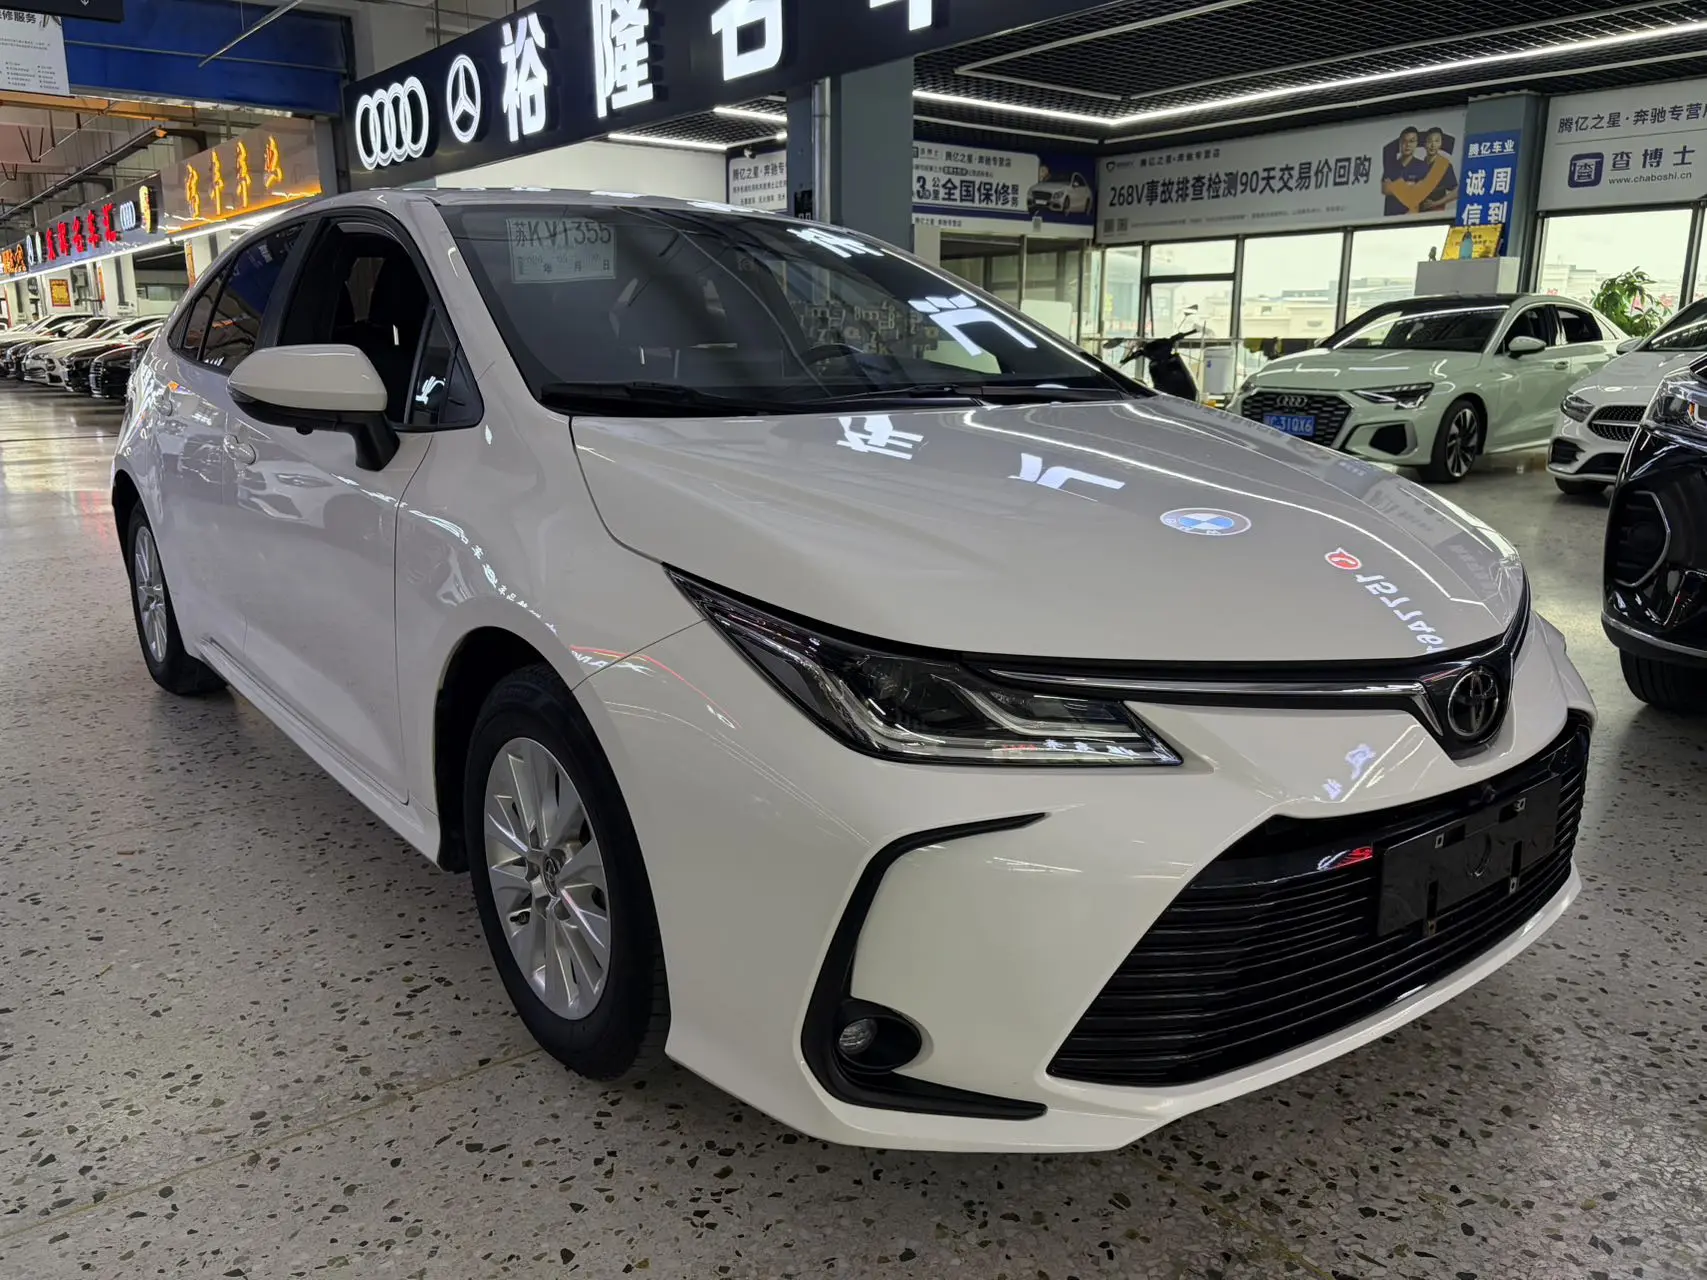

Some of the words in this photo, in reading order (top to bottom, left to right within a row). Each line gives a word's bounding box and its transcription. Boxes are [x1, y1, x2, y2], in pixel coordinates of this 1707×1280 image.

[0, 10, 37, 24] 修服务
[1468, 140, 1515, 156] 腾亿车业
[1610, 145, 1695, 171] 查博士
[1608, 171, 1692, 184] www.chaboshi.cn
